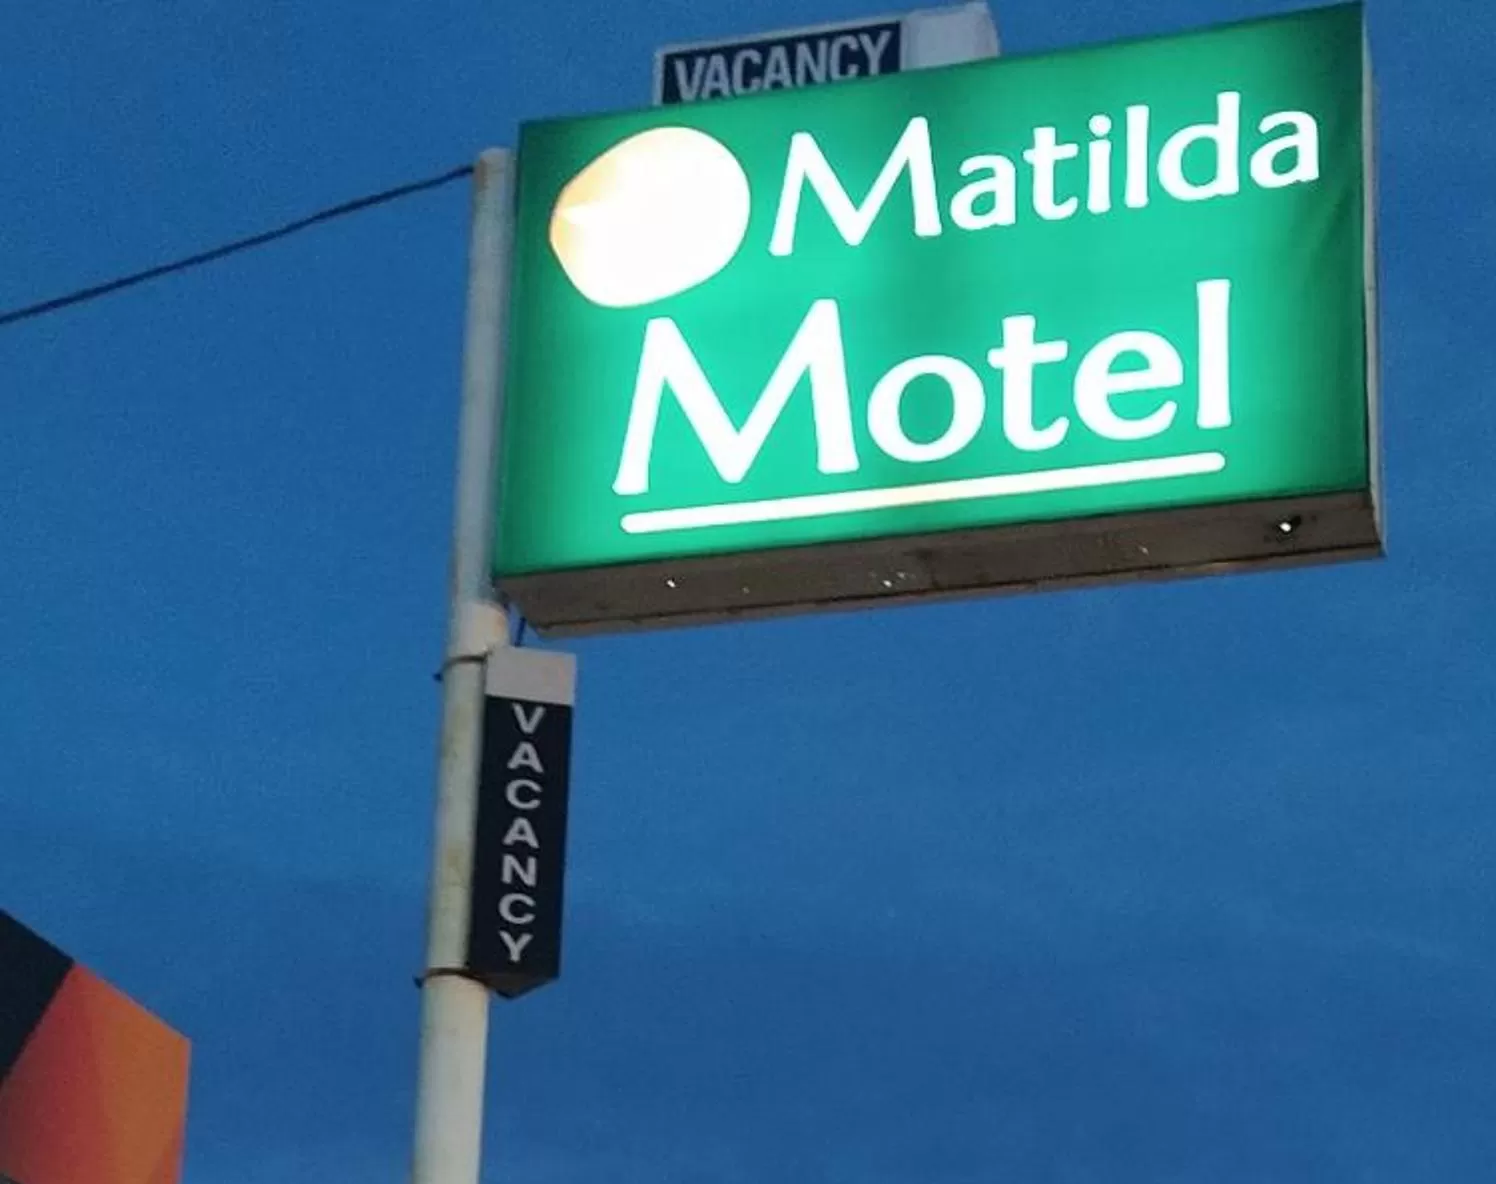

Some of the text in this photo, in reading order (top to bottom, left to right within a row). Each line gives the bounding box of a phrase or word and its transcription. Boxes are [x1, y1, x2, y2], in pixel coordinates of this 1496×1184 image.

[674, 30, 892, 101] VACANCY
[769, 91, 1320, 257] Matilda
[613, 279, 1233, 495] Motel
[498, 702, 547, 963] VACANCY
